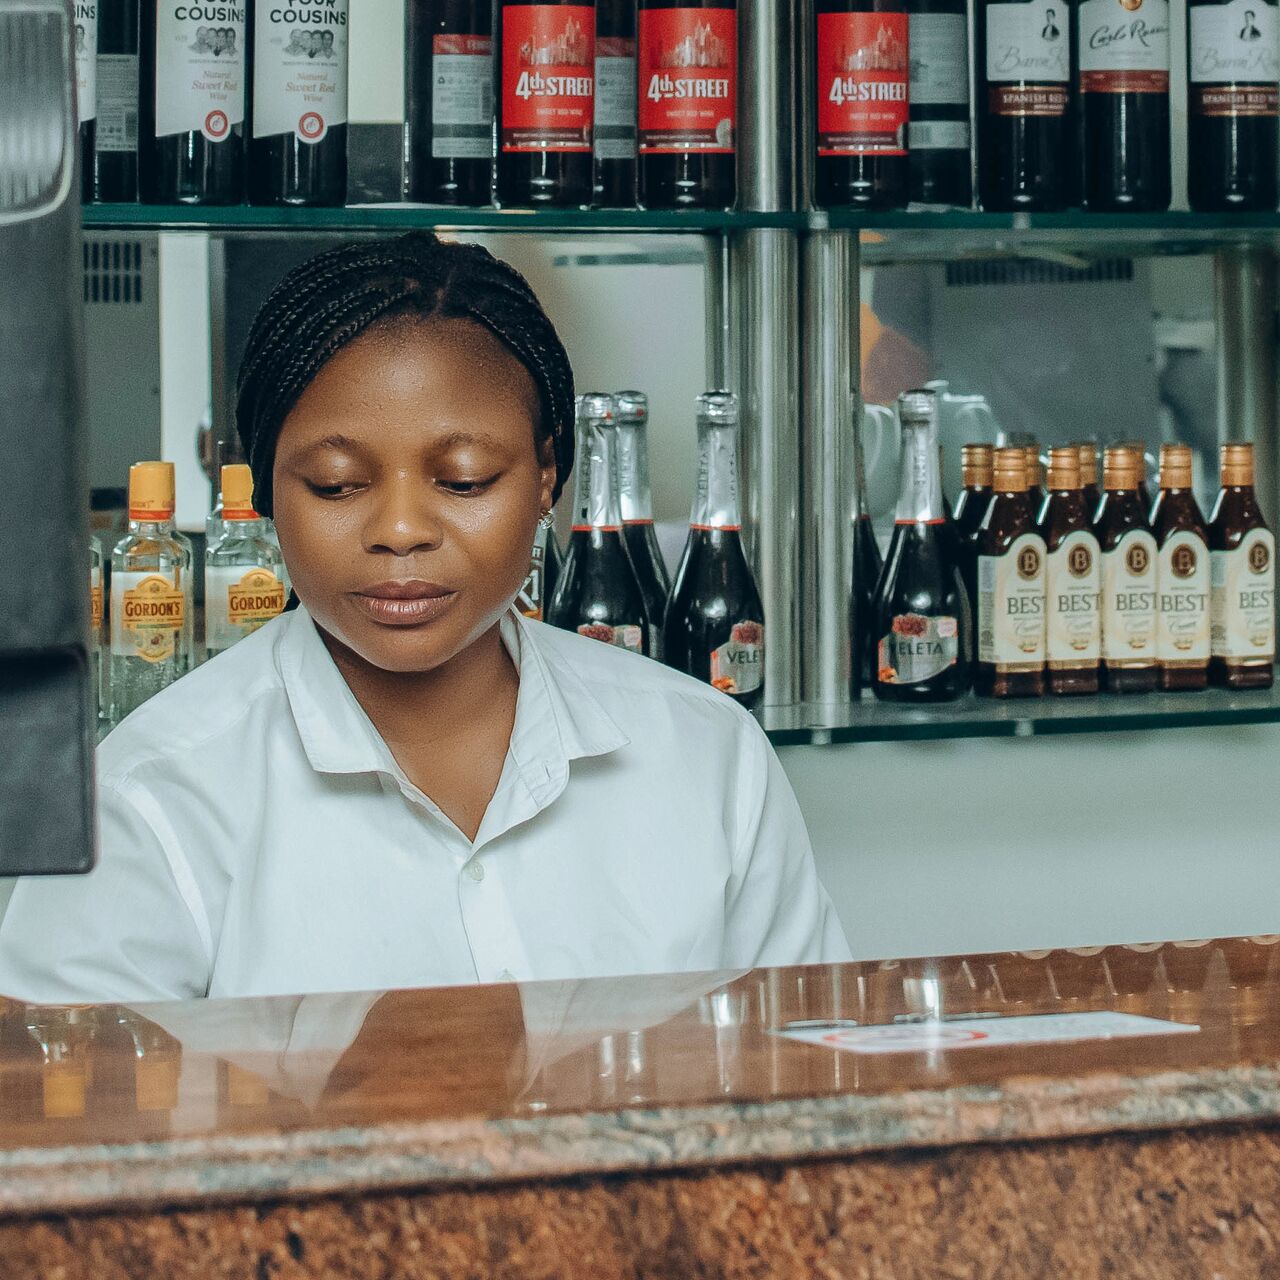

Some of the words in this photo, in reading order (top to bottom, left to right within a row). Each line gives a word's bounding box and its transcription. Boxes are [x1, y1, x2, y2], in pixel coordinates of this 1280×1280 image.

[270, 9, 347, 26] COUSINS
[674, 78, 728, 99] STREET
[125, 601, 181, 618] GORDON'S
[1160, 593, 1209, 613] BEST
